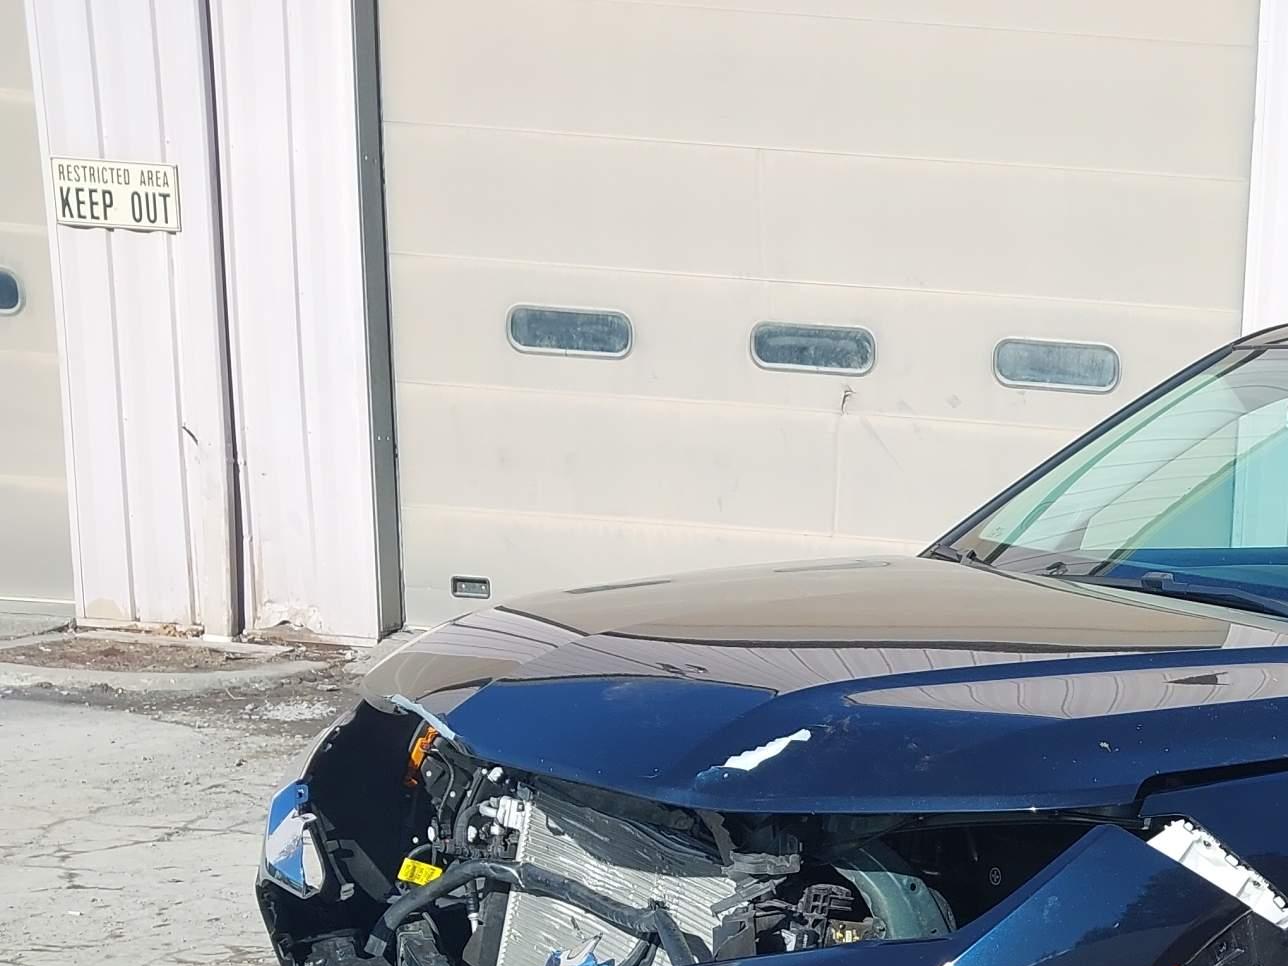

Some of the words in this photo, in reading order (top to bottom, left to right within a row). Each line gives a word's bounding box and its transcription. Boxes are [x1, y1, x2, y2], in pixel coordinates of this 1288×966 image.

[58, 163, 130, 185] RESTRICTED
[140, 169, 170, 188] AREA
[59, 186, 114, 221] KEEP
[131, 191, 171, 225] OUT
